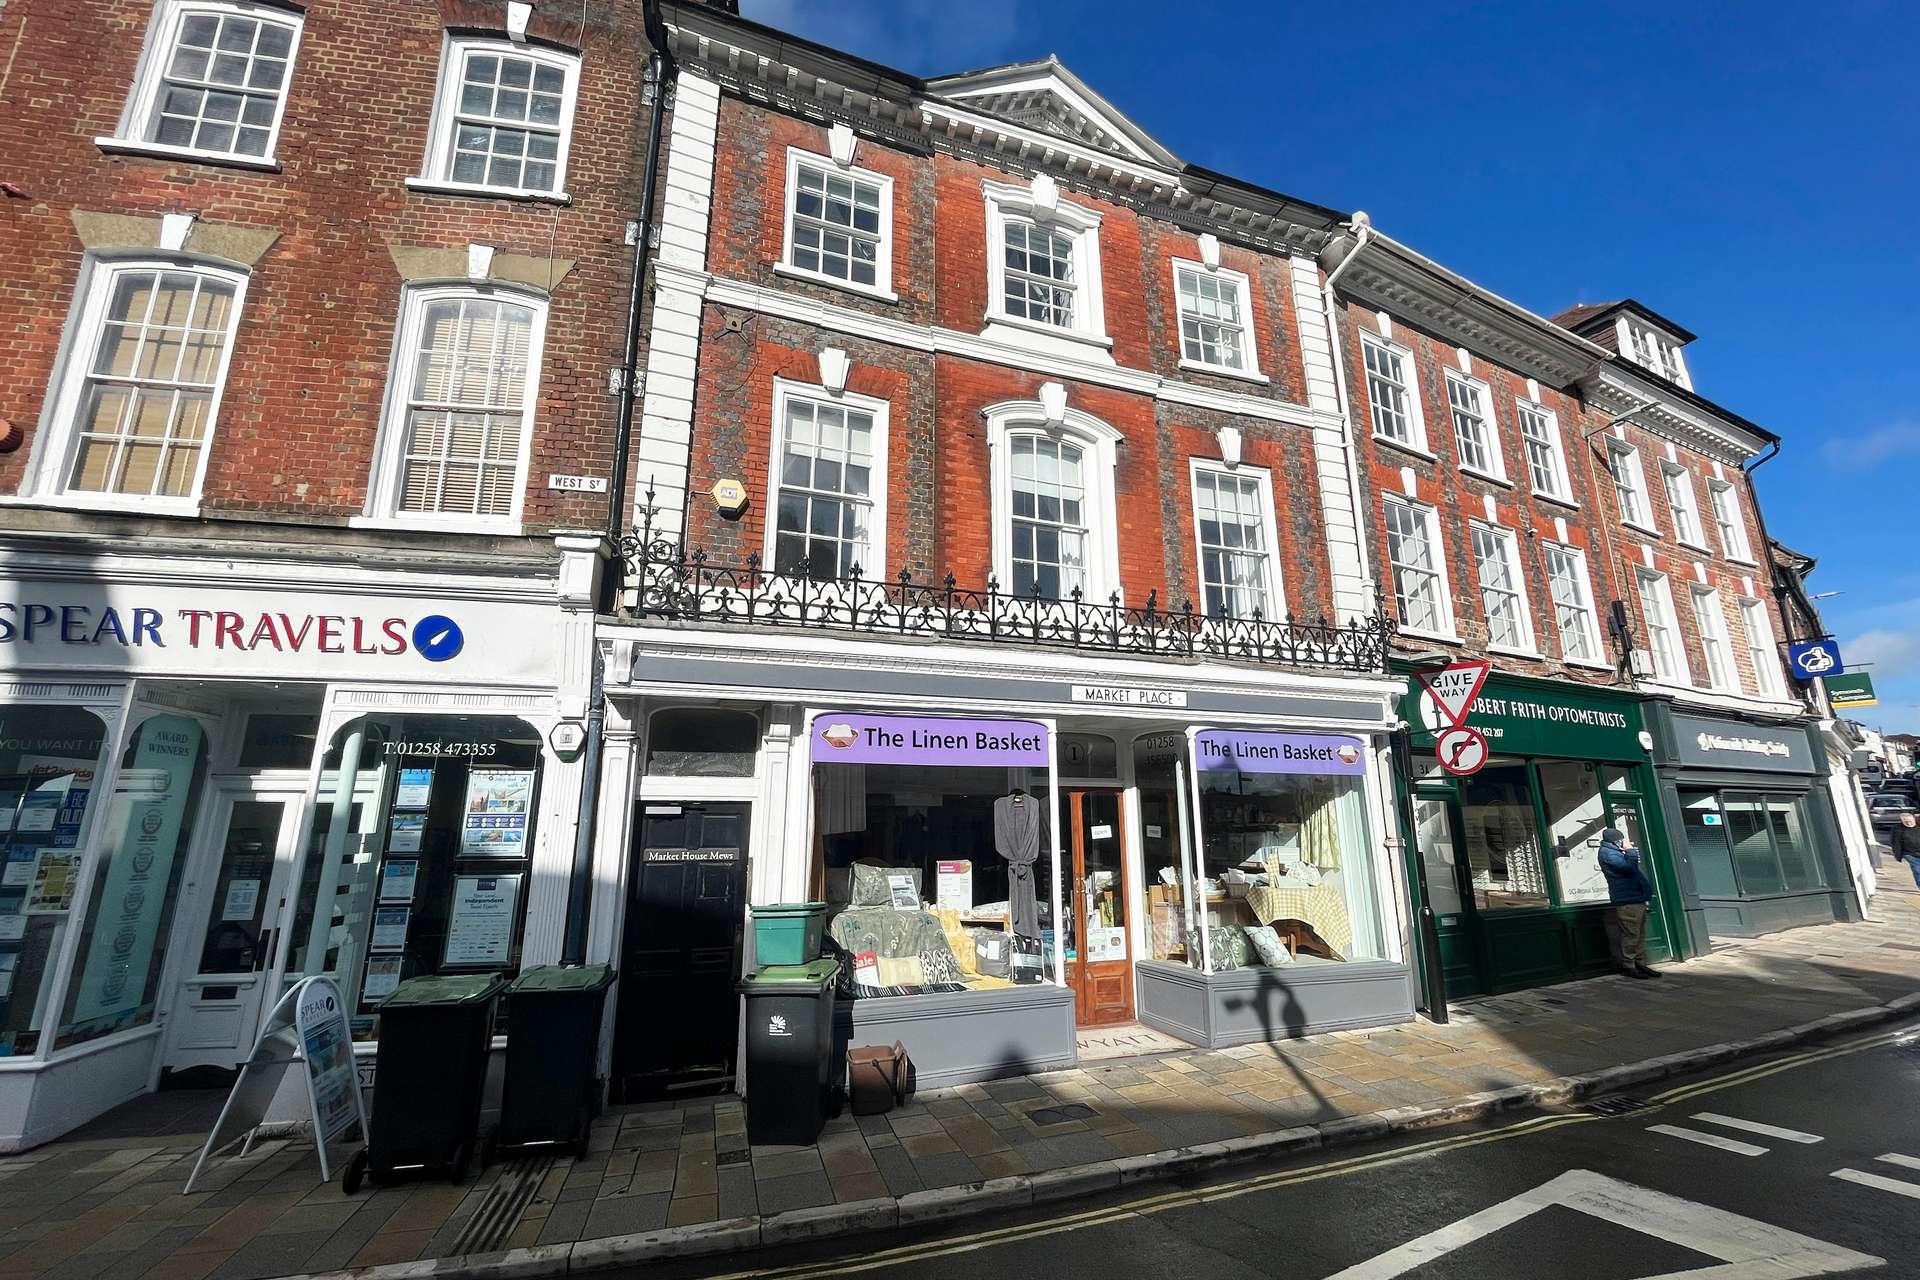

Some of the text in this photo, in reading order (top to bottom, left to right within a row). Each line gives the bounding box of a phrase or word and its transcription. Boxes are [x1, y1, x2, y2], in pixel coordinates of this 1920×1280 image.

[555, 476, 583, 489] WEST
[0, 602, 408, 655] SPEAR TRAVELS
[1430, 673, 1473, 688] GIVE
[1085, 688, 1174, 705] MARKET PLACE
[1440, 688, 1466, 698] WAY
[1469, 697, 1627, 728] OBERT FRITH OPTOMETRISTS
[155, 731, 189, 744] AWARD
[864, 727, 1041, 751] The Linen Basket
[1146, 735, 1175, 750] 01258
[0, 738, 32, 751] YOU
[36, 740, 84, 752] WANT
[148, 743, 190, 757] WINNERS
[382, 742, 497, 756] T.01258 473355
[1201, 739, 1333, 761] The Linen Basket
[648, 851, 734, 861] Market House Mews
[852, 956, 873, 968] Sale
[301, 998, 326, 1018] SPEAR
